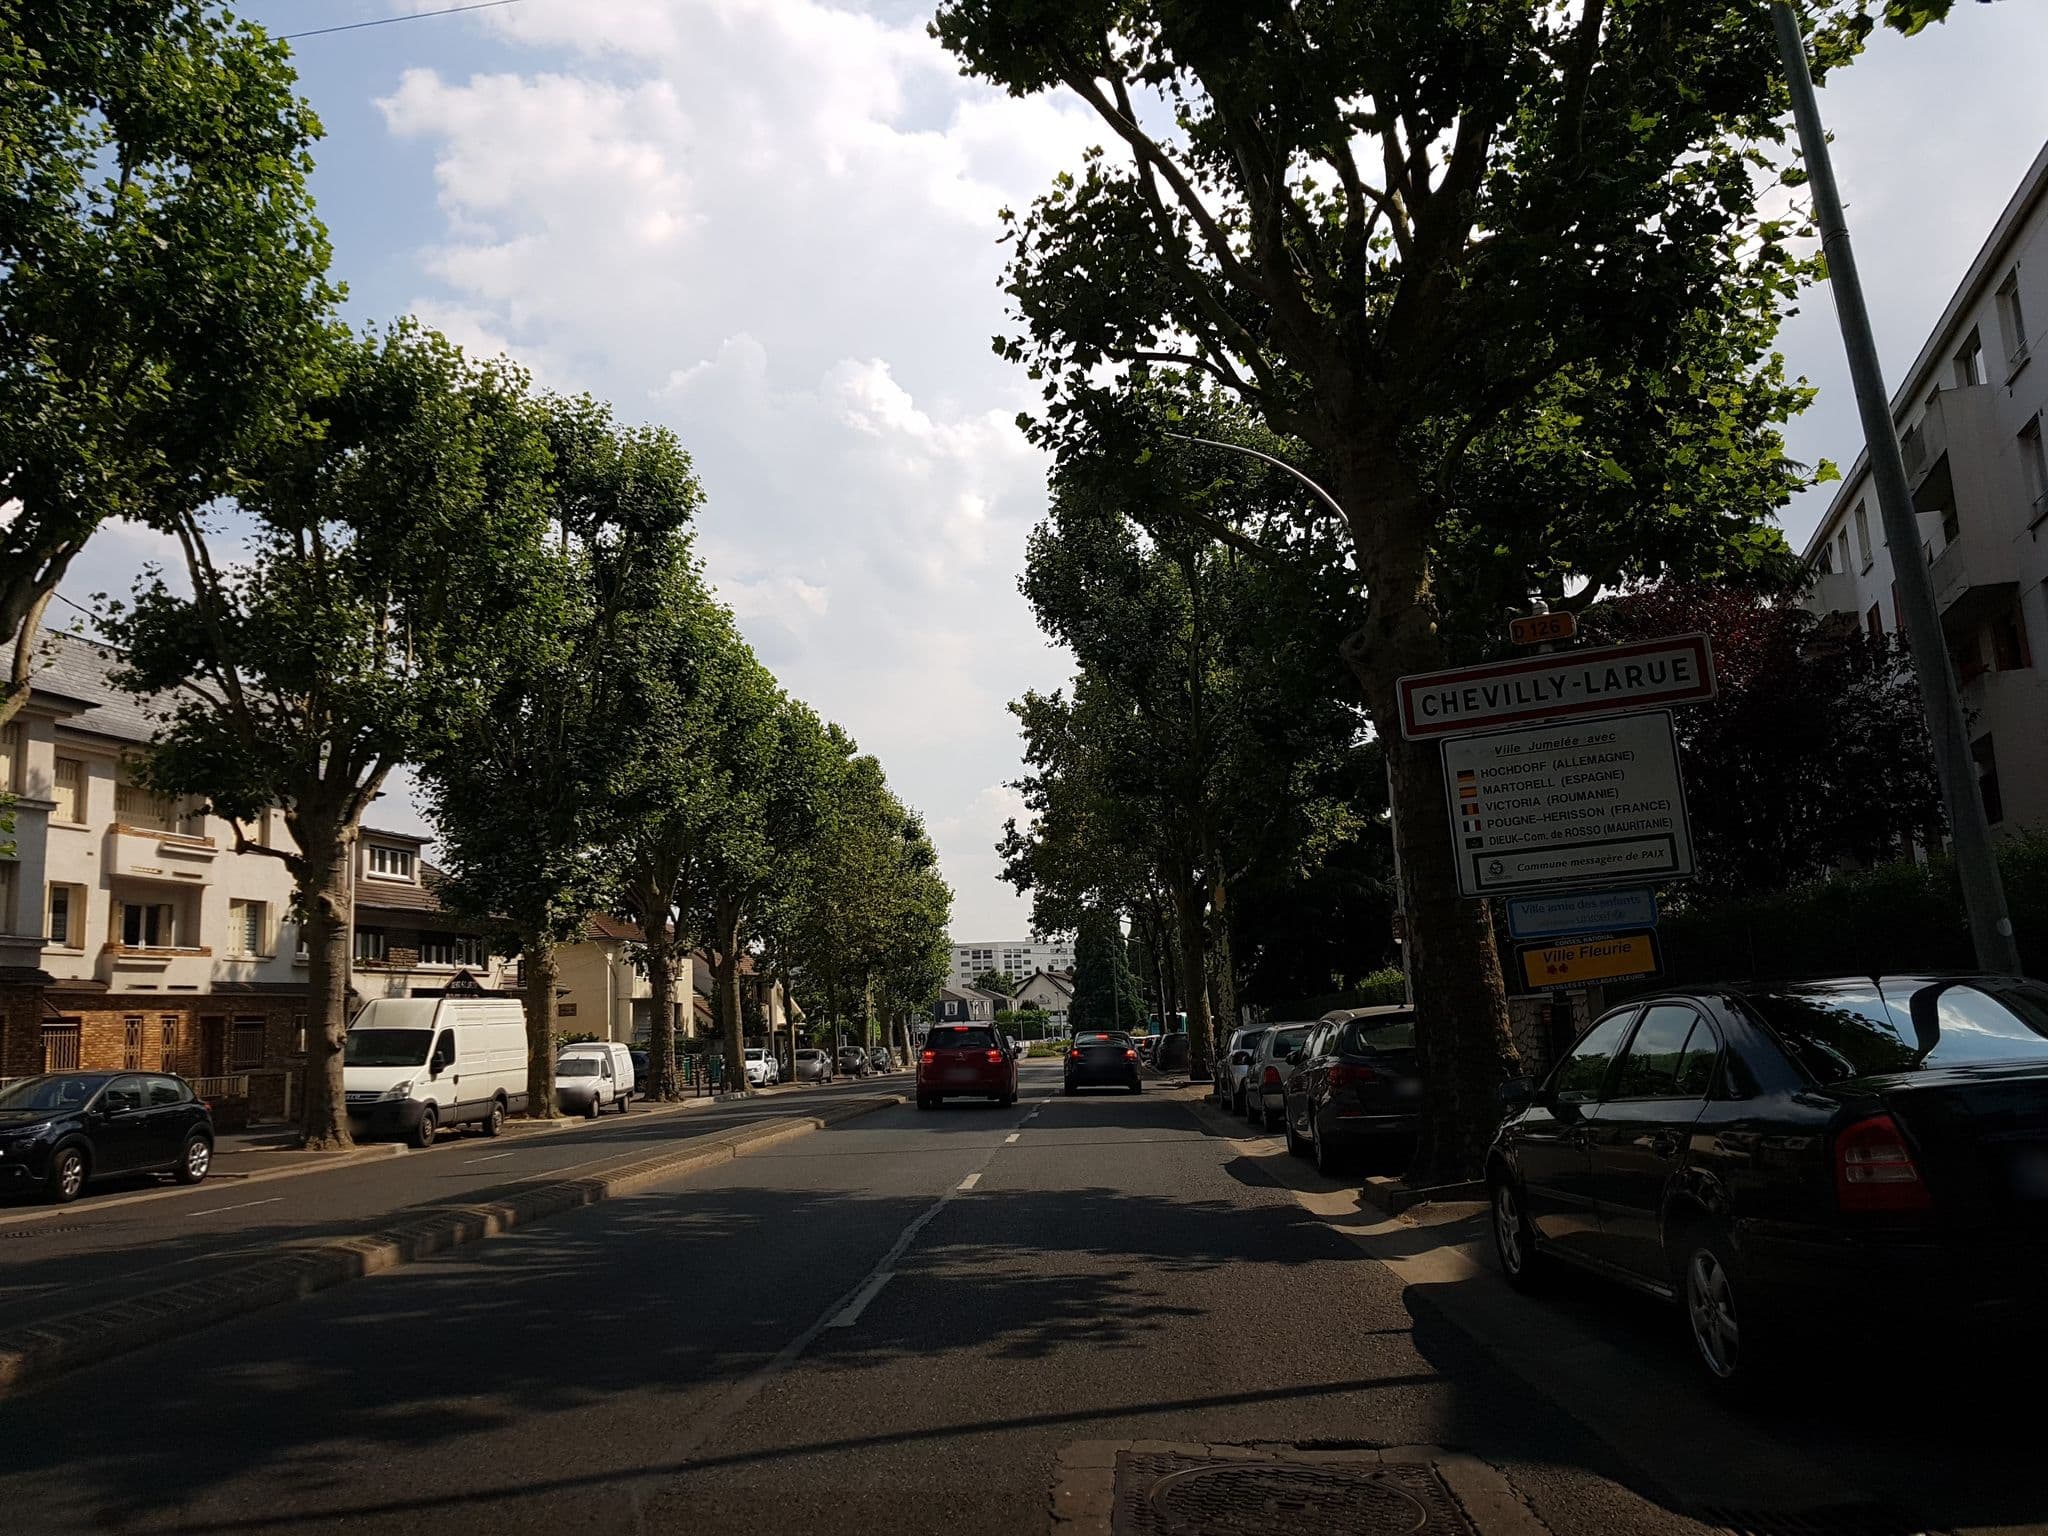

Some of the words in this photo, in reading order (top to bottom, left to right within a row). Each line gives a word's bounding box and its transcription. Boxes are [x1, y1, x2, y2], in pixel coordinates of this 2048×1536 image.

[1513, 625, 1524, 640] D
[1531, 620, 1560, 636] 126
[1421, 657, 1691, 717] CHEVILLY-LARUE
[1494, 743, 1521, 755] Ville
[1528, 737, 1579, 751] Jumelée
[1587, 732, 1616, 743] avec
[1480, 761, 1547, 779] HOCHDORF
[1552, 750, 1635, 771] (ALLEMAGNE)
[1483, 778, 1555, 795] MARTORELL
[1561, 769, 1625, 788] (ESPAGNE)
[1485, 796, 1541, 812] VICTORIA
[1547, 787, 1619, 806] (ROUMANIE)
[1610, 799, 1671, 818] (FRANCE)
[1550, 829, 1563, 839] de
[1565, 824, 1601, 838] ROSSO
[1603, 817, 1673, 837] (MAURITANIE)
[1517, 860, 1568, 872] Commune
[1570, 853, 1623, 868] messagère
[1625, 851, 1639, 861] de
[1641, 848, 1665, 859] PAIX
[1520, 902, 1545, 915] Ville
[1576, 900, 1596, 910] des
[1554, 938, 1582, 947] CONSEIL
[1583, 934, 1615, 944] NATIONAL
[1543, 949, 1574, 963] Ville
[1580, 942, 1632, 959] Fleurie
